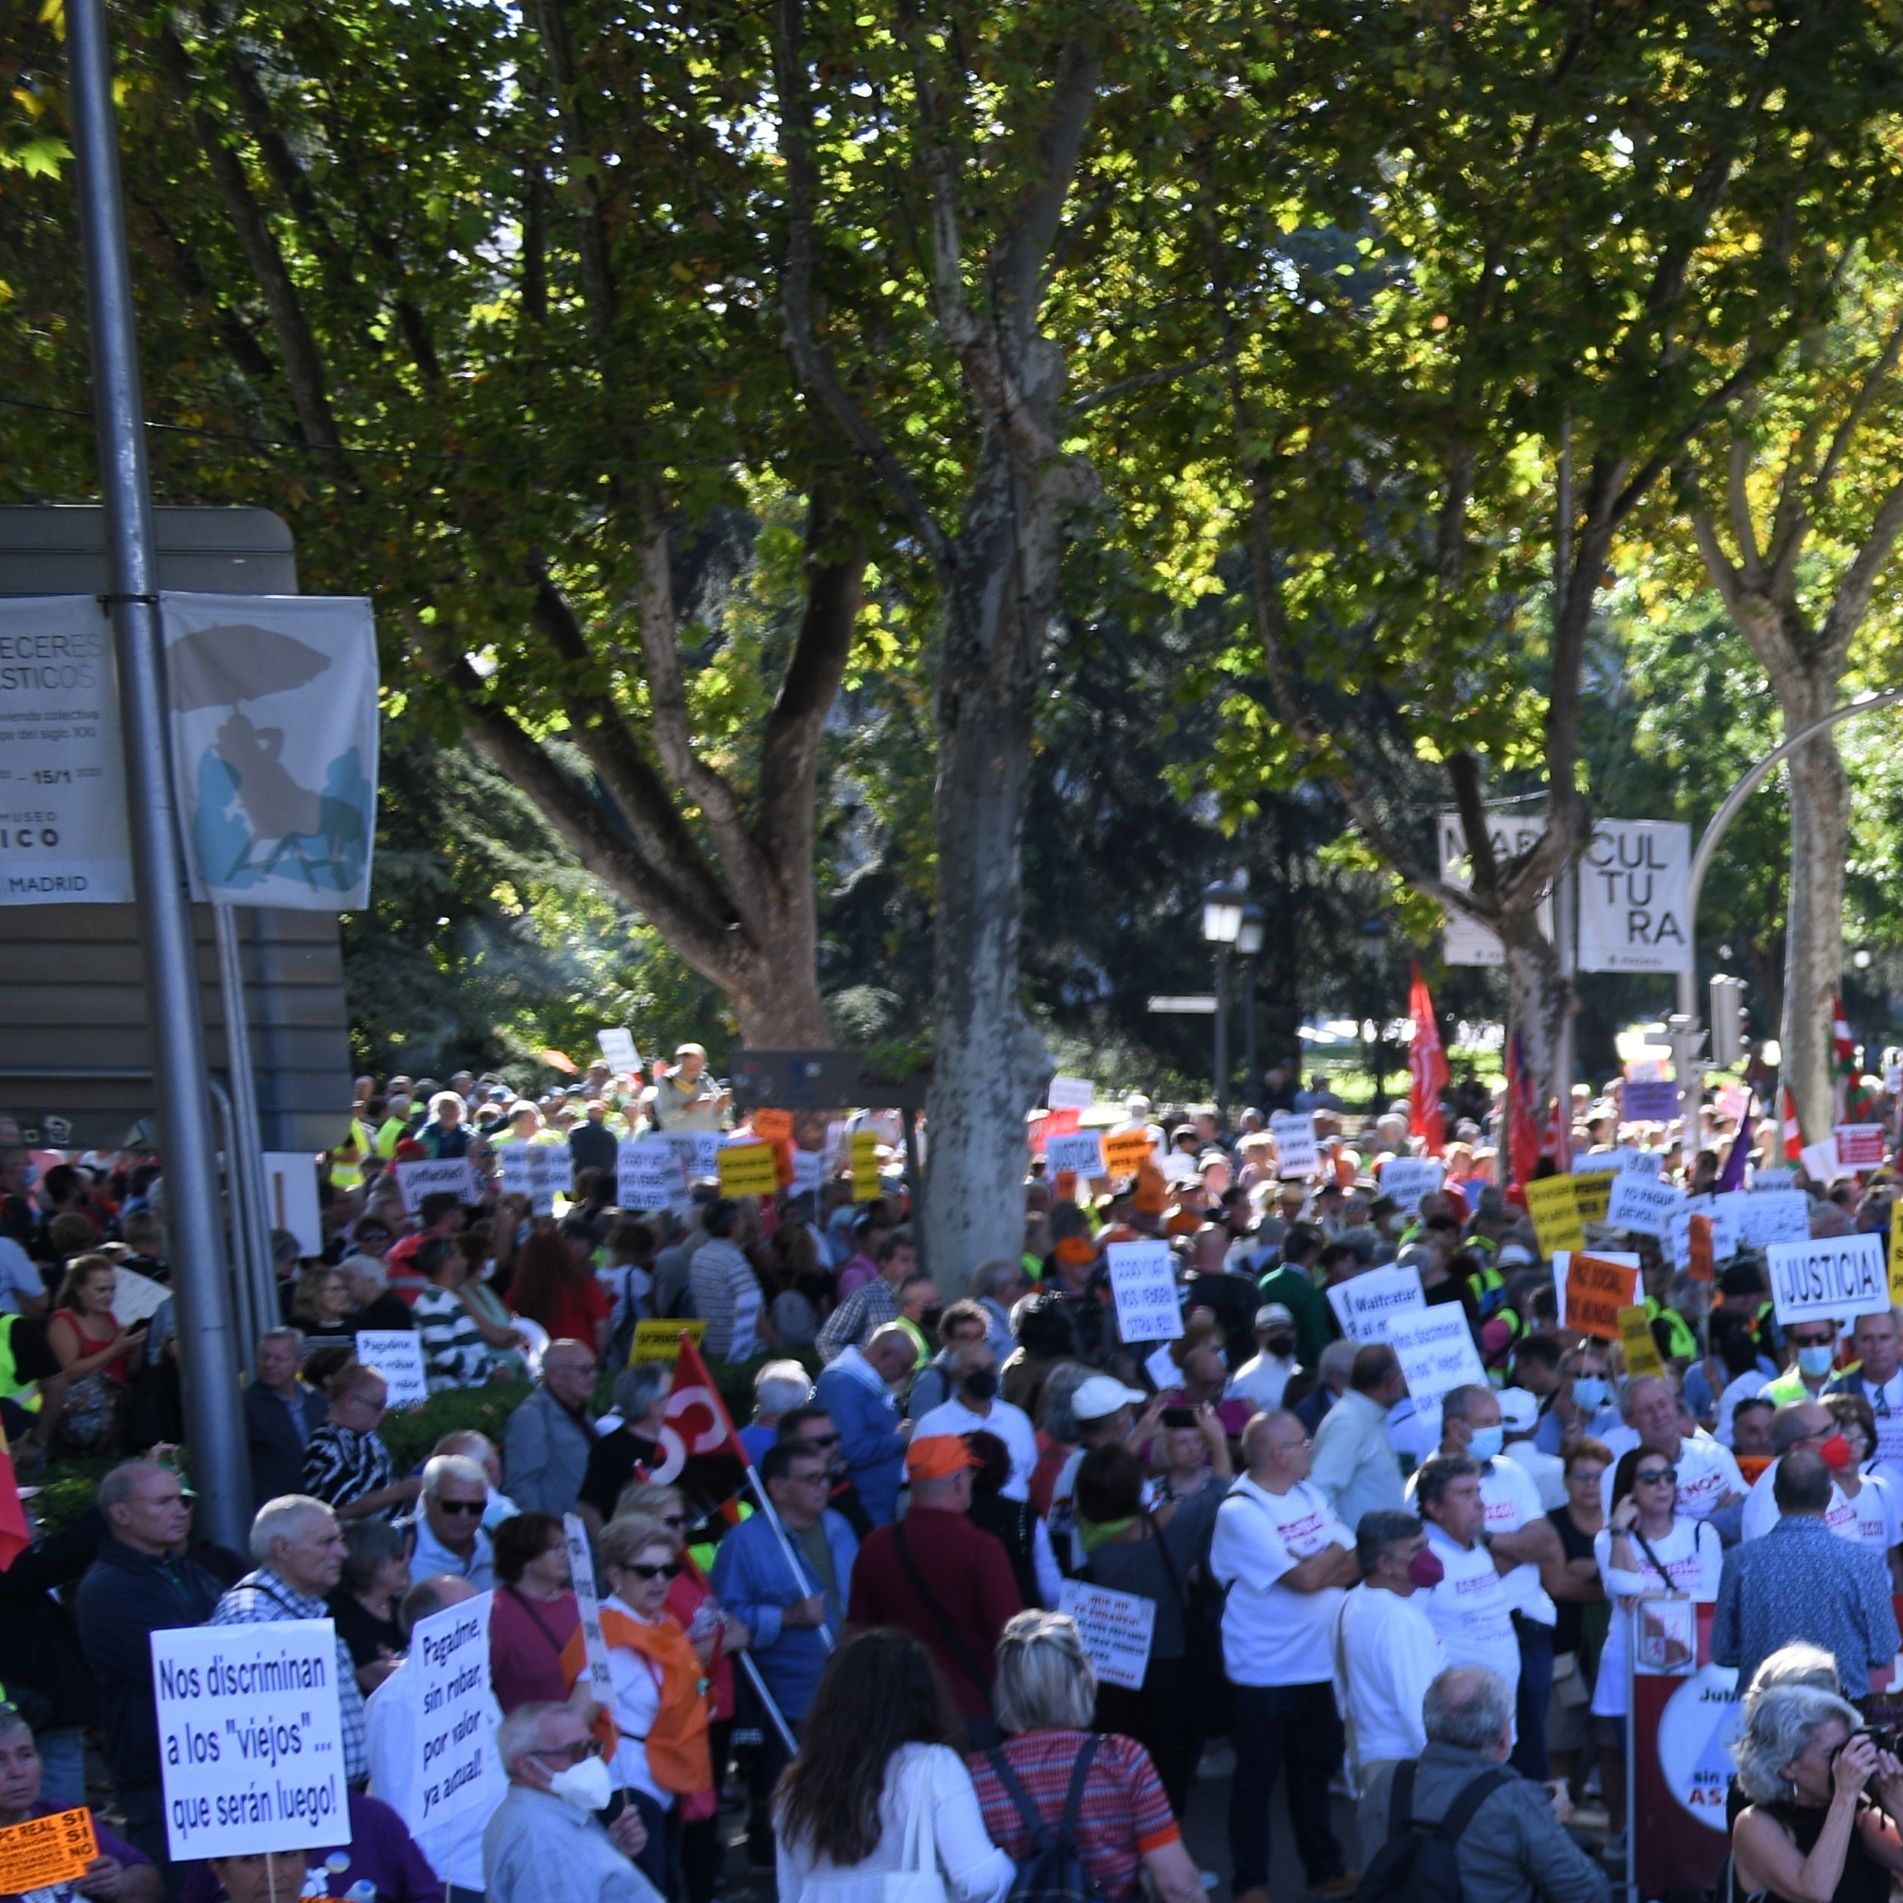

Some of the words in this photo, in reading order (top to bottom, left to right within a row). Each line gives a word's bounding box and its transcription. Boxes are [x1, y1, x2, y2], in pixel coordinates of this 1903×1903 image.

[1598, 870, 1652, 906] TU
[1628, 911, 1685, 945] RA
[1778, 1249, 1881, 1306] ¡JUSTICIA!
[159, 1659, 200, 1700] Nos
[207, 1649, 325, 1696] discriminan
[424, 1683, 443, 1715] sin
[167, 1735, 179, 1765] a
[185, 1723, 220, 1764] los
[423, 1732, 448, 1772] por
[452, 1710, 480, 1748] valor
[173, 1797, 210, 1839] que
[217, 1782, 272, 1826] serán
[276, 1773, 336, 1827] luego!
[423, 1786, 440, 1819] ya
